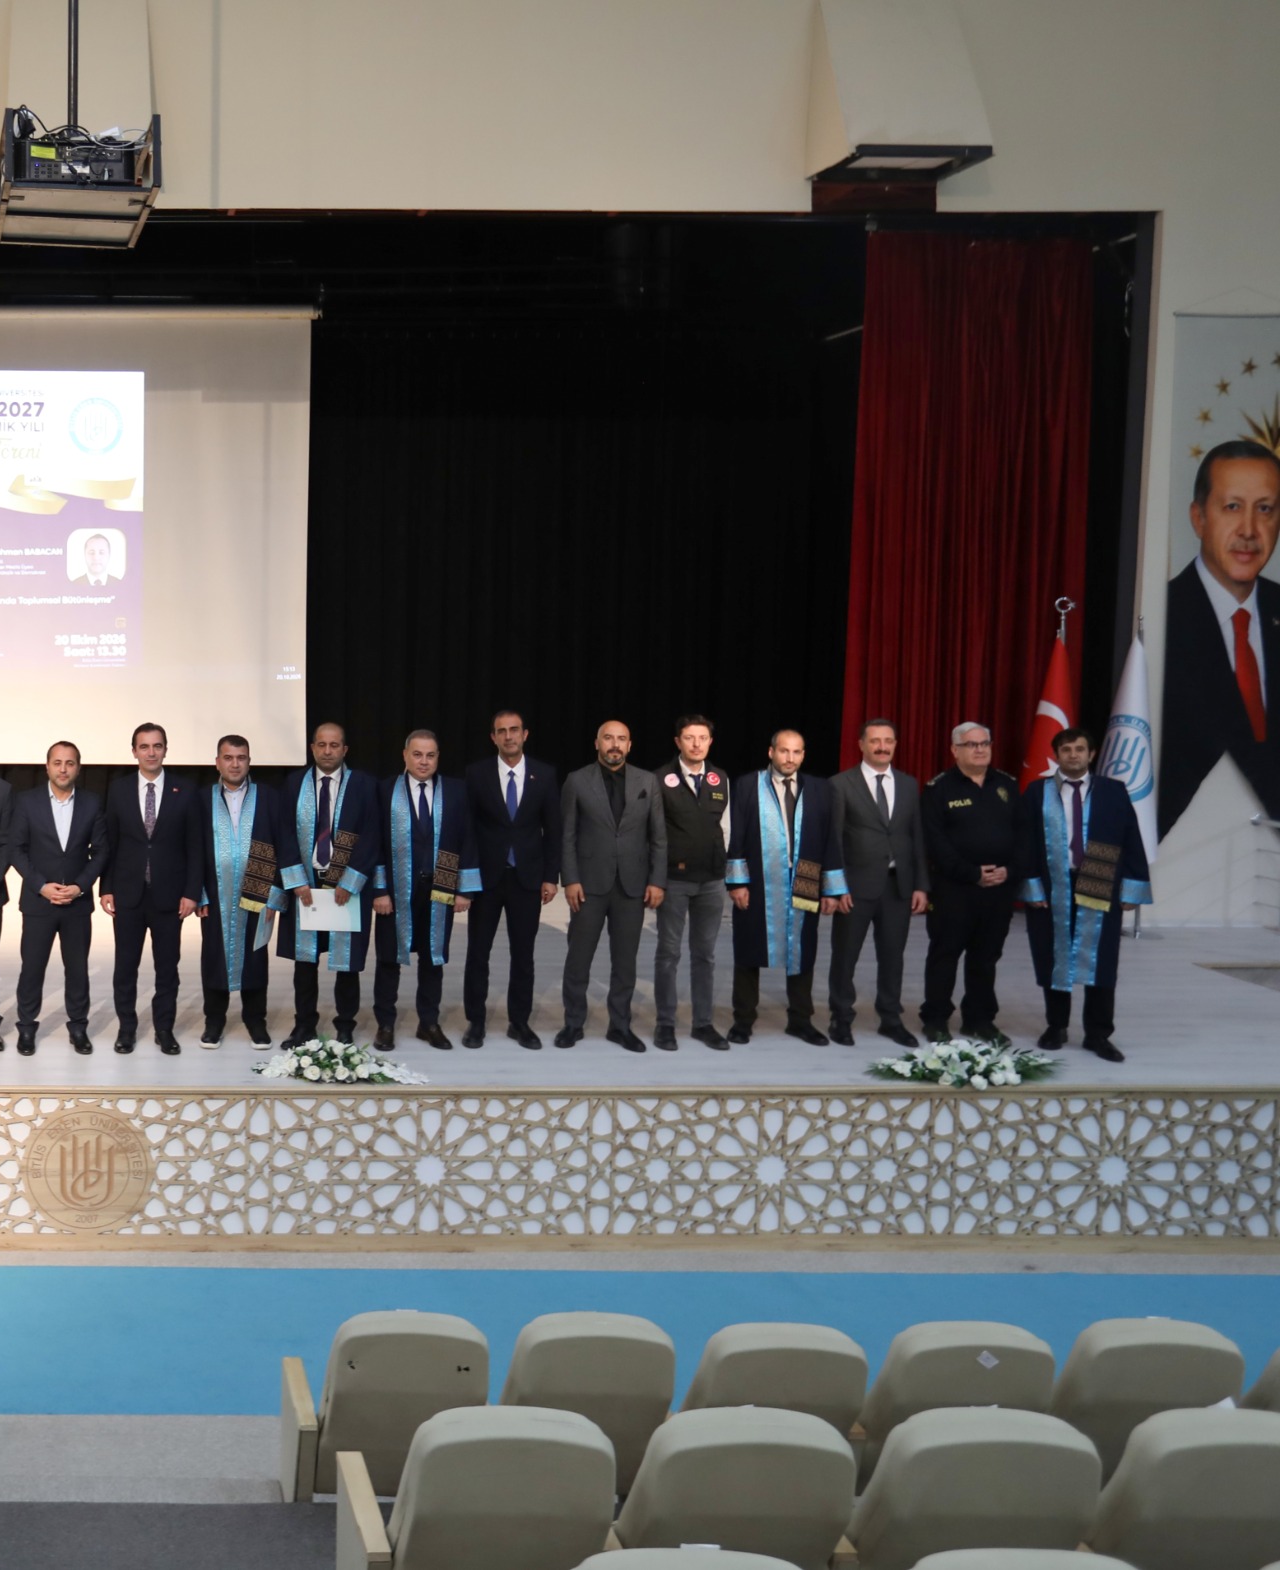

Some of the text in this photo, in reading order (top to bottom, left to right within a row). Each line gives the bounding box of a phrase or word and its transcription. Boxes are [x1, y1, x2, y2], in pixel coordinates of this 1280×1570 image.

[20, 421, 45, 432] YILI
[948, 798, 972, 808] POLİS
[46, 1116, 80, 1140] EREN
[75, 1214, 98, 1224] 2007
